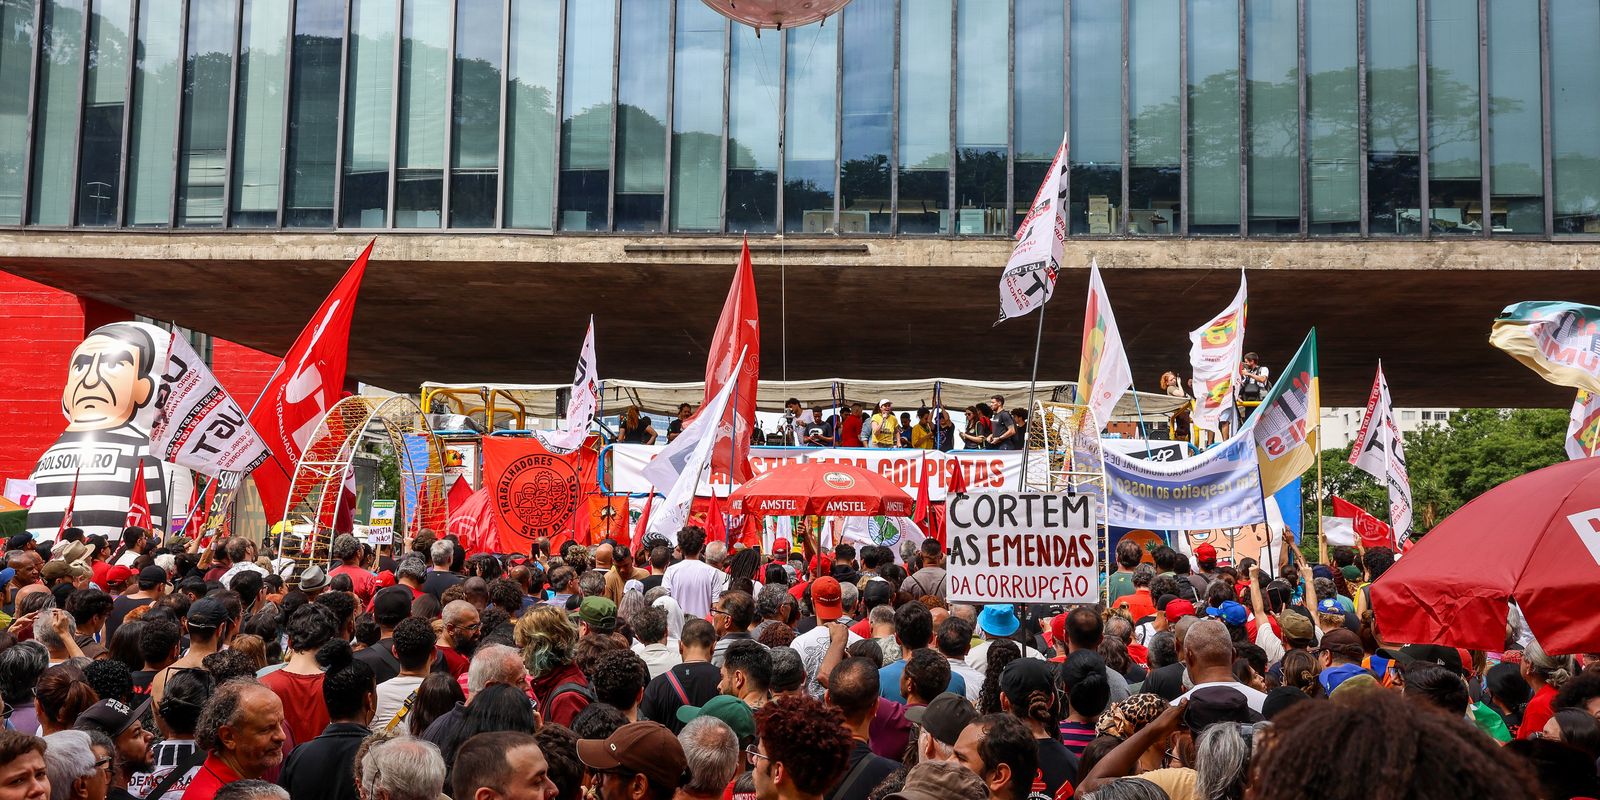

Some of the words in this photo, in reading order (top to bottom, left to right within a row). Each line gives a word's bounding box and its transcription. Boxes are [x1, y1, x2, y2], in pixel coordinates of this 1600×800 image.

[276, 402, 307, 476] TRABALHADORS
[500, 456, 553, 514] TRABALHADORES
[760, 500, 796, 510] AMSTEL
[826, 501, 866, 512] AMSTEL
[886, 501, 904, 512] AMSTEL
[950, 494, 1089, 528] CORTEM
[370, 526, 392, 536] ANISTIA
[520, 524, 549, 537] SEM
[950, 533, 980, 566] AS
[986, 533, 1095, 568] EMENDAS
[952, 574, 972, 596] DA
[974, 572, 1089, 600] CORRUPÇÃO
